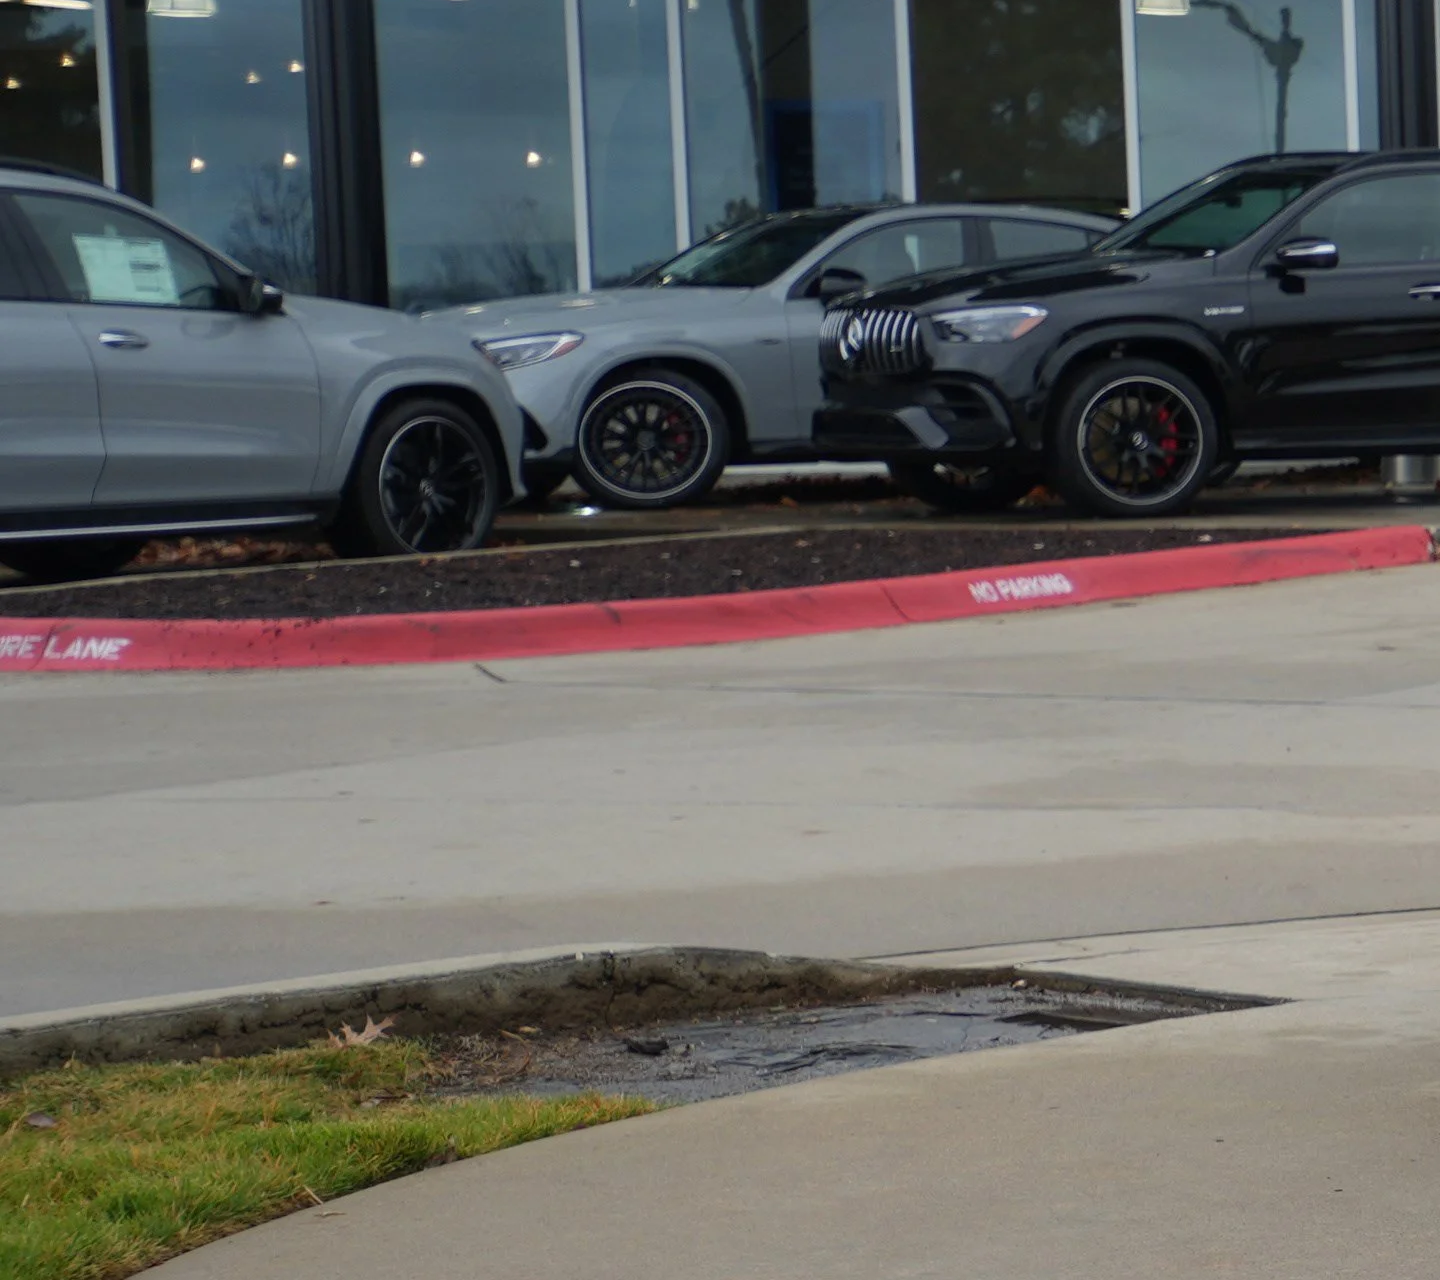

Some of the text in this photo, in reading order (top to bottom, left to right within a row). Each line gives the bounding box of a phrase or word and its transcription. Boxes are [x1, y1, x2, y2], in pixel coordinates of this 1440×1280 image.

[968, 573, 1073, 603] NO PARKING
[43, 635, 132, 660] LANE
